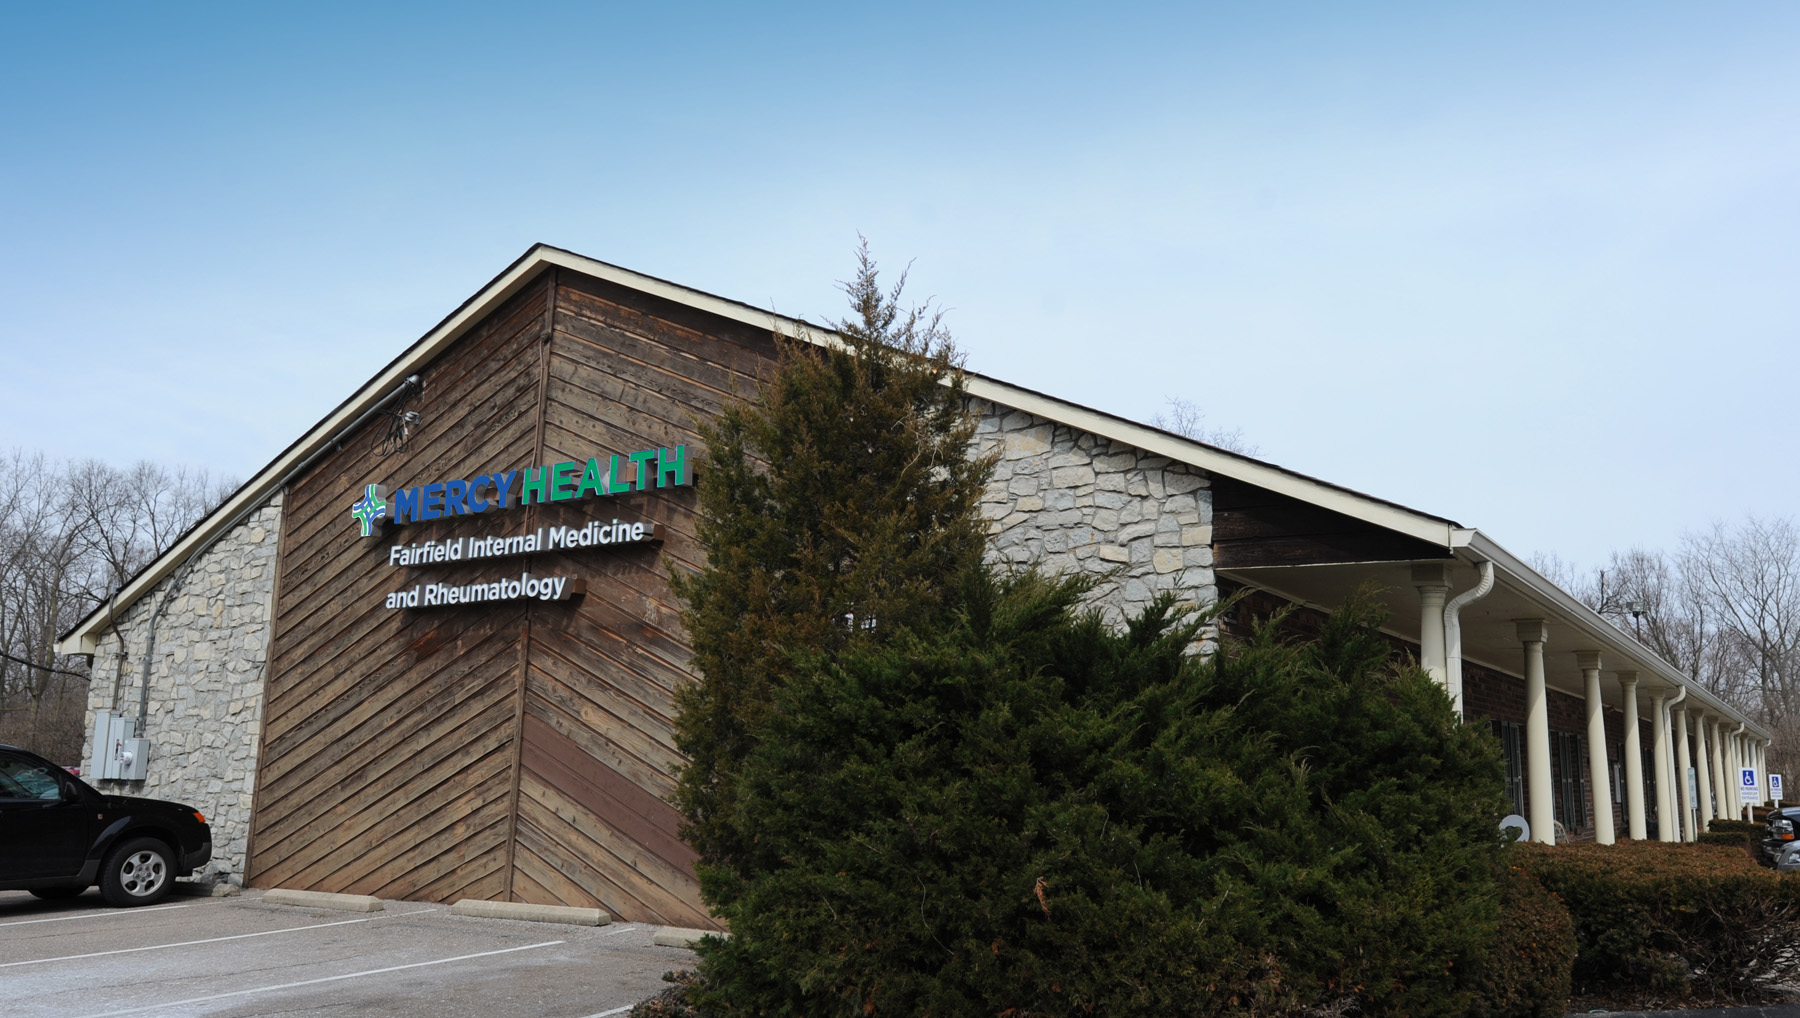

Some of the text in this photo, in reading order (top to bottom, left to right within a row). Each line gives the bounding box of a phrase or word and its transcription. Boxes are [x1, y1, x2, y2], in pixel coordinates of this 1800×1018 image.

[394, 445, 685, 524] MERCY HEALTH
[389, 518, 644, 566] Fairfield Internal Medicine
[385, 572, 567, 609] and Rheumatology
